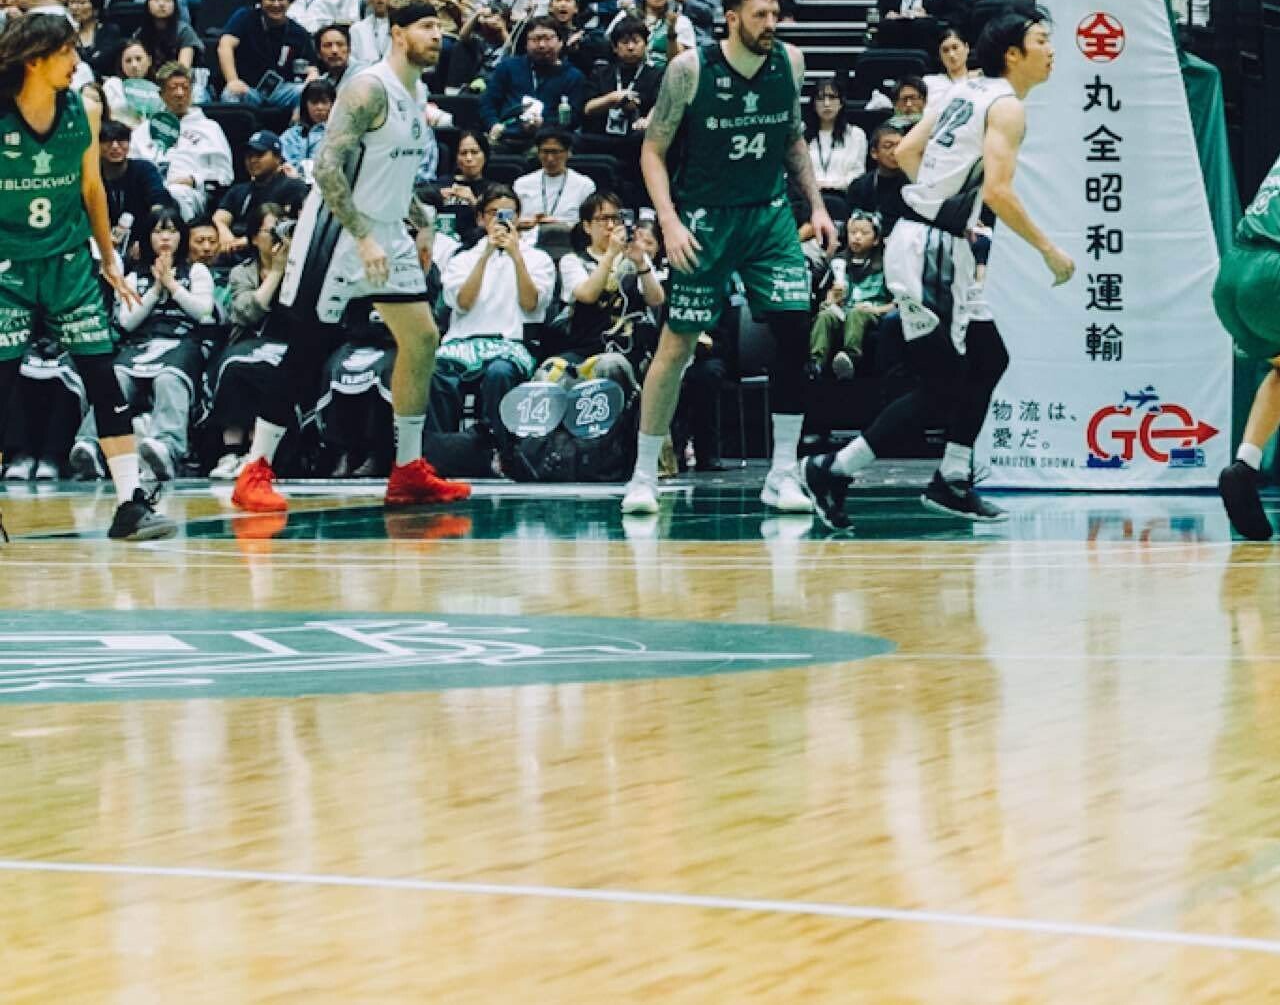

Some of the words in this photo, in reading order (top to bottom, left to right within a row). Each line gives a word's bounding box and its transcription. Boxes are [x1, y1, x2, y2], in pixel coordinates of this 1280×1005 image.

[728, 132, 766, 161] 34
[28, 197, 52, 229] 8
[1083, 75, 1124, 362] 丸全昭和運輸
[518, 396, 550, 424] 14
[576, 394, 609, 426] 23
[992, 399, 1078, 422] 物流は、
[992, 427, 1050, 450] 愛だ。
[989, 455, 1036, 469] MARUZEN
[1040, 456, 1077, 469] SHOWA
